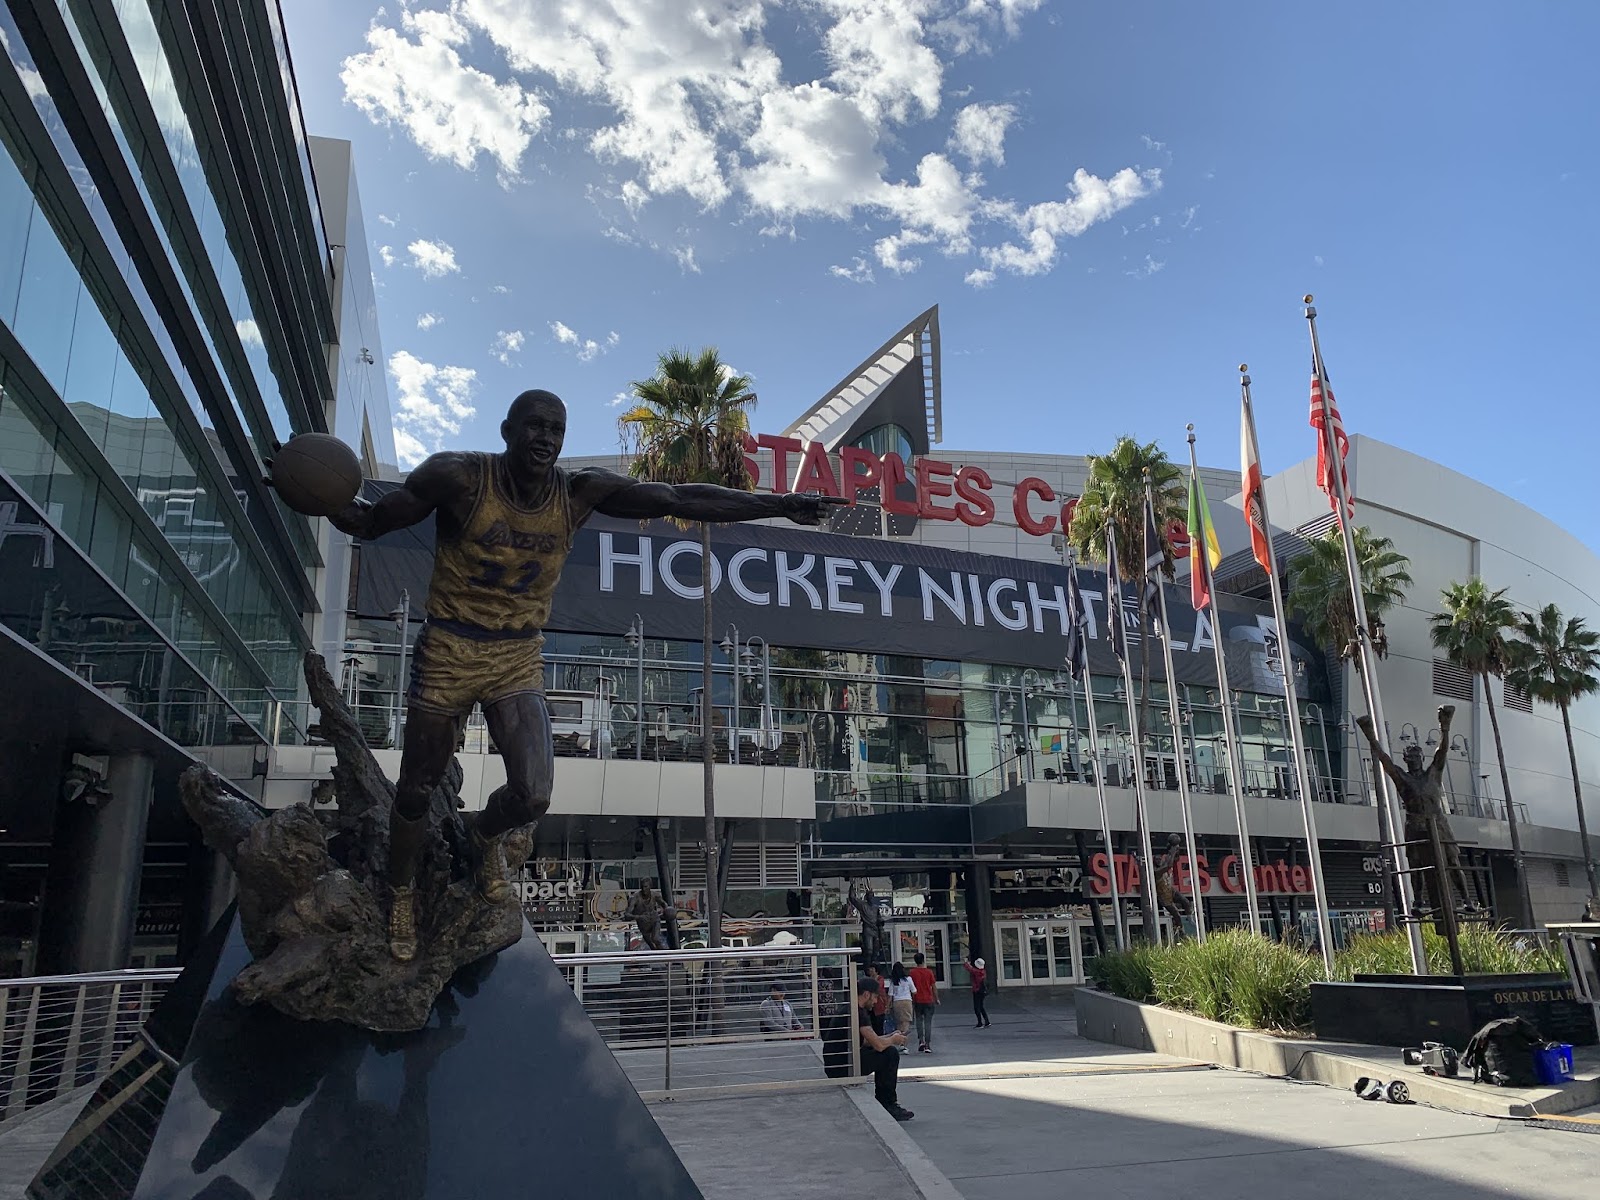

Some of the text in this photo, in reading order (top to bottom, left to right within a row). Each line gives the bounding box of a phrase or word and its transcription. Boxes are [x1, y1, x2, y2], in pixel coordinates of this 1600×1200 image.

[599, 532, 904, 617] HOCKEY
[918, 567, 1103, 640] NIGHT
[548, 905, 577, 913] GRILL
[1494, 991, 1530, 1004] OSCAR
[1532, 990, 1548, 1002] DE
[1550, 989, 1564, 1001] LA
